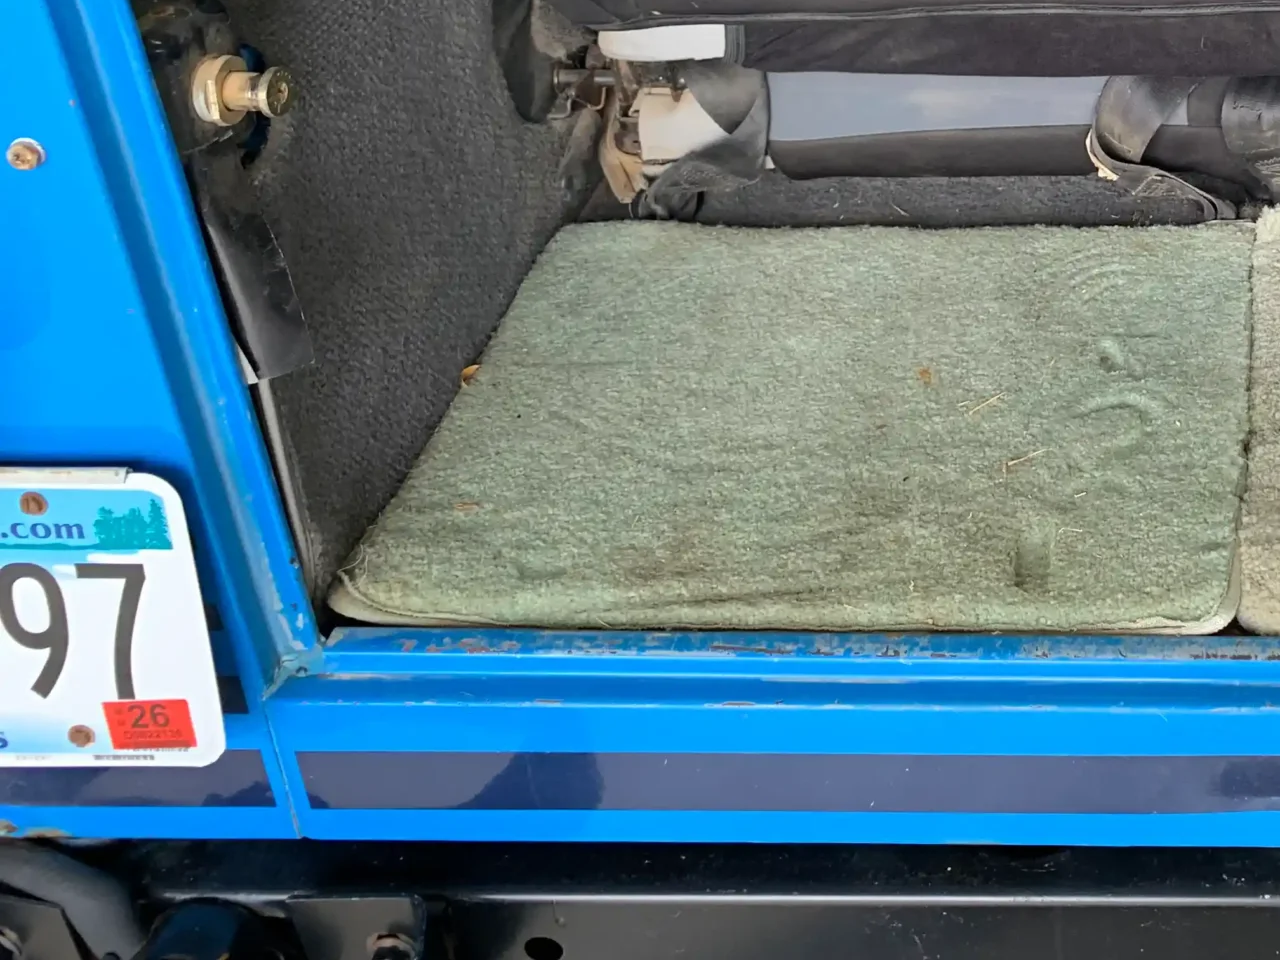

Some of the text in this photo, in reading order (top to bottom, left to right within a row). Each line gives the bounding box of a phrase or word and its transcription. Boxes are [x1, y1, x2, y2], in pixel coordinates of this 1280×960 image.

[1, 522, 86, 539] .com
[0, 562, 146, 700] 97
[127, 703, 170, 729] 26
